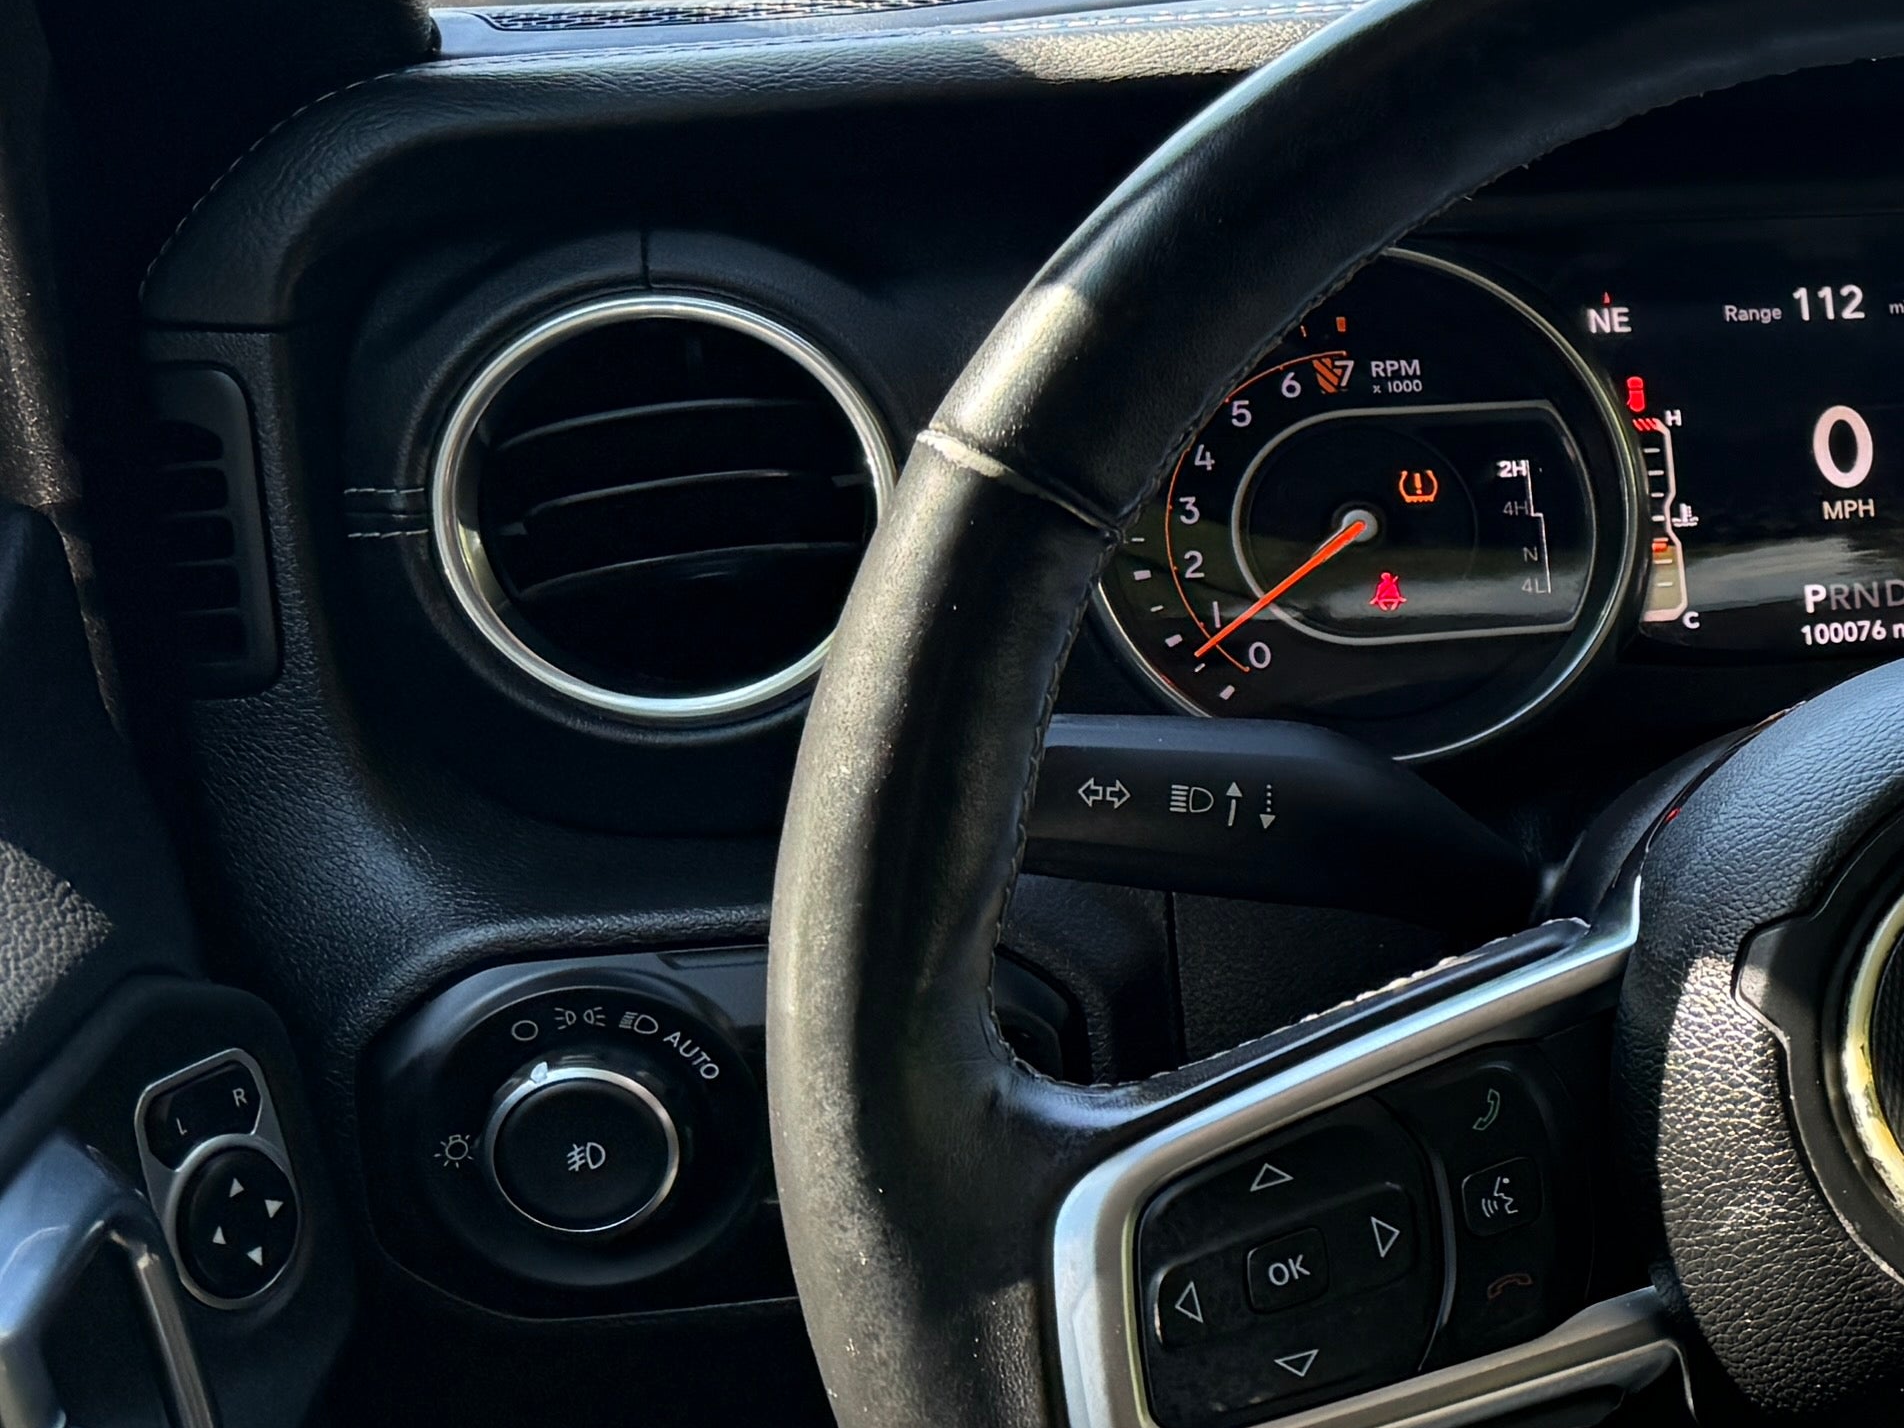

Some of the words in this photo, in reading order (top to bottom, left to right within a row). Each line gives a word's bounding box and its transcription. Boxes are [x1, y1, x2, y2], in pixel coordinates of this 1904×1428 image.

[1724, 305, 1783, 324] Range
[1792, 285, 1865, 321] 112
[1588, 307, 1632, 335] NE
[1337, 361, 1355, 387] 7
[1370, 360, 1422, 377] RPM
[1280, 373, 1301, 398] 6
[1388, 379, 1423, 393] 1000
[1231, 400, 1252, 428] 5
[1665, 410, 1682, 427] H
[1194, 445, 1216, 470] 4
[1813, 405, 1873, 488] 0
[1499, 462, 1528, 478] 2H
[1179, 498, 1200, 523] 3
[1503, 500, 1528, 516] 4H
[1822, 500, 1875, 520] MPH
[1184, 551, 1205, 578] 2
[1523, 546, 1538, 561] N
[1521, 578, 1546, 593] 4L
[1212, 601, 1222, 629] 1
[1683, 612, 1700, 629] C
[1800, 622, 1888, 646] 100076
[1248, 641, 1271, 668] 0
[662, 1030, 720, 1081] AUTO
[233, 1088, 248, 1107] R
[175, 1118, 188, 1135] L
[1268, 1254, 1311, 1286] OK
